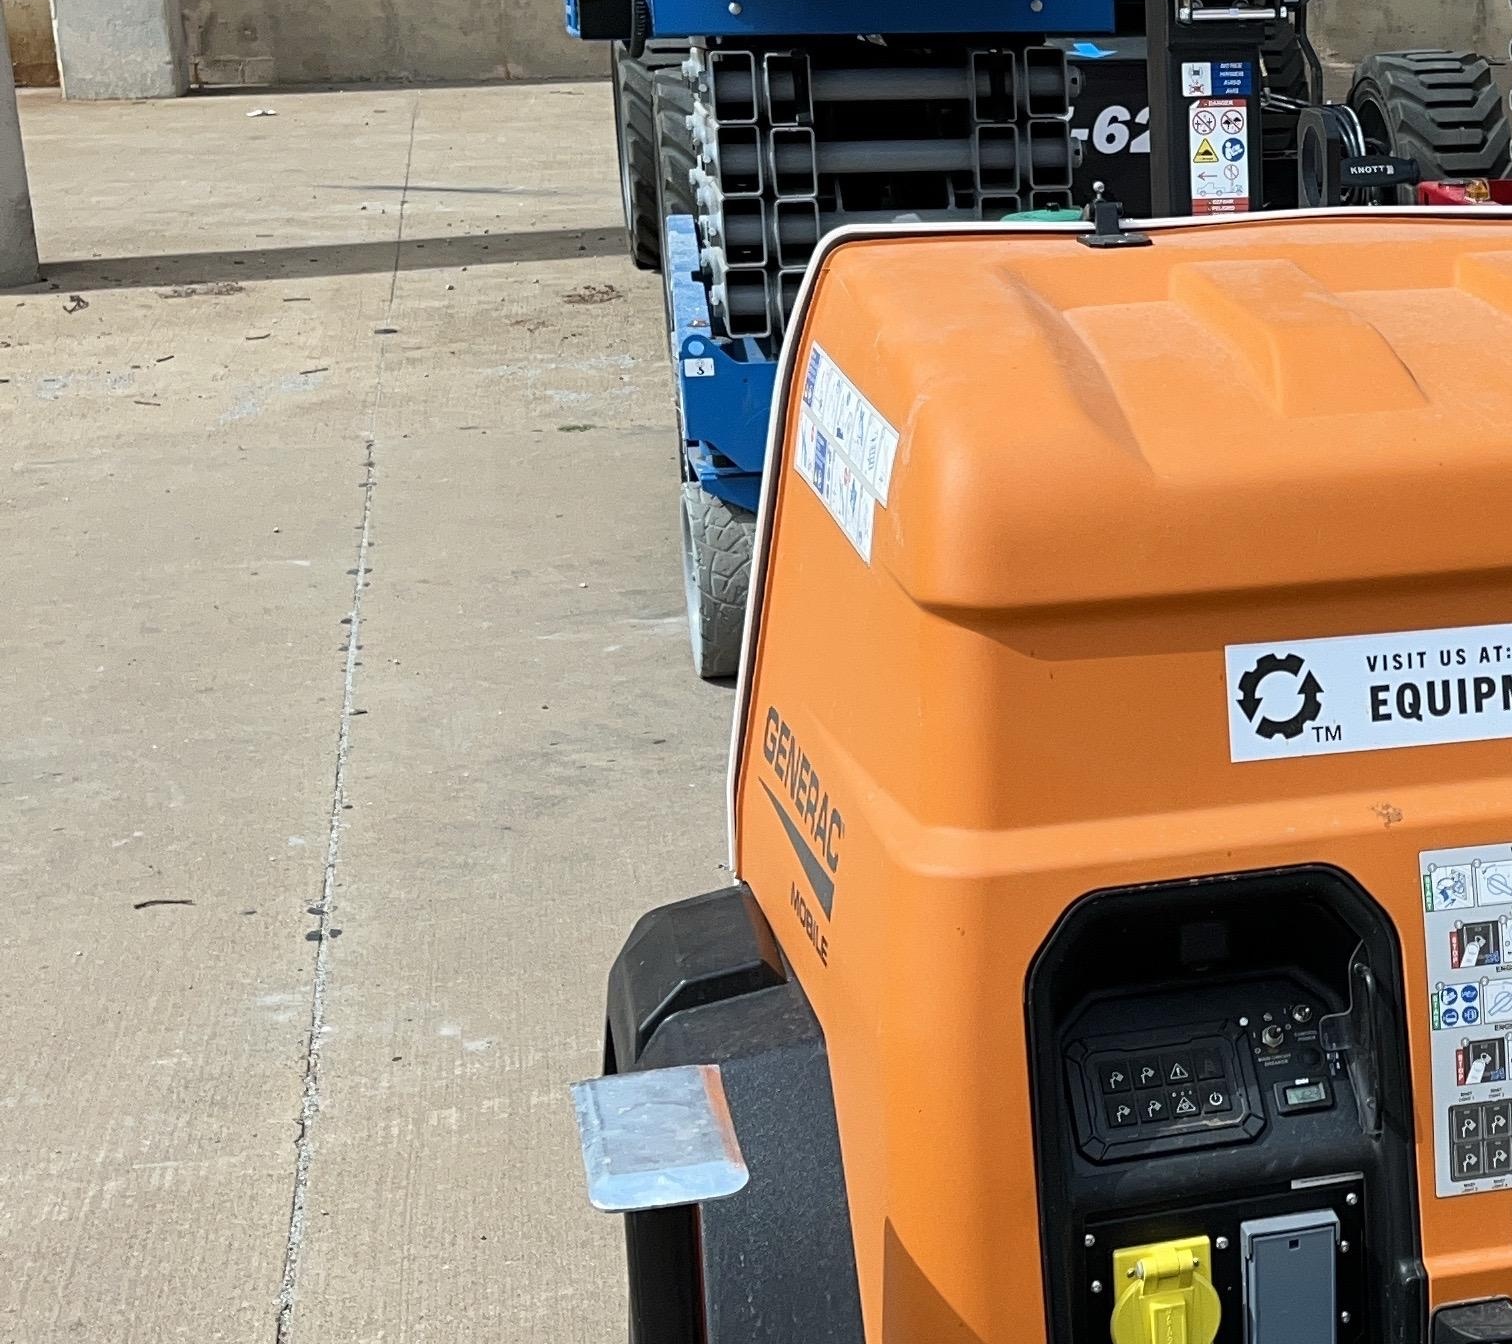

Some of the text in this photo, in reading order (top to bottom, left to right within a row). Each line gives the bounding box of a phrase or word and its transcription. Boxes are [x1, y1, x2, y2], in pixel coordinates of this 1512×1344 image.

[1366, 644, 1512, 672] VISIT US AT:
[1311, 724, 1343, 743] TM
[763, 706, 842, 874] GENERAC
[790, 881, 829, 968] MOBILE
